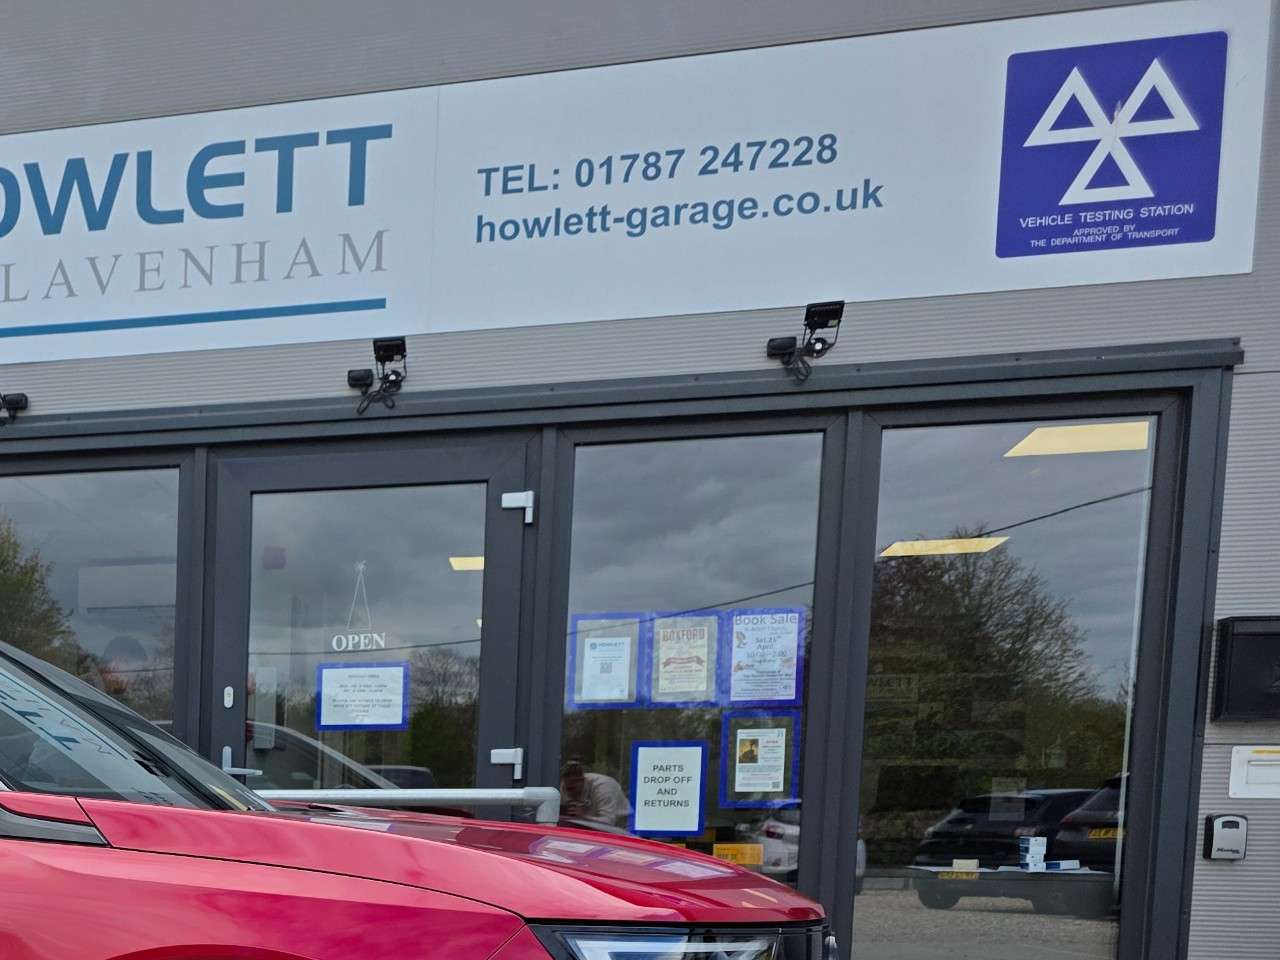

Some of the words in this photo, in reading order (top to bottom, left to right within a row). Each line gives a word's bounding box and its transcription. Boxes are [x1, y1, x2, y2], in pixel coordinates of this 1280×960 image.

[477, 163, 561, 197] TEL:
[575, 148, 686, 188] 01787
[697, 132, 839, 176] 247228
[475, 178, 885, 243] howlett-garage.co.uk
[1020, 213, 1073, 228] VEHICLE
[1079, 208, 1134, 223] TESTING
[1140, 204, 1194, 218] STATION
[1030, 239, 1047, 248] THE
[1050, 234, 1106, 247] DEPARTMENT
[1110, 232, 1123, 241] OF
[1127, 228, 1180, 239] TRANSPORT
[1072, 224, 1119, 236] APPROVED
[1123, 224, 1136, 233] BY
[0, 229, 389, 304] LAVENHAM
[735, 613, 767, 626] Book
[771, 612, 798, 625] Sale
[331, 632, 387, 651] OPEN
[652, 764, 684, 772] PARTS
[643, 776, 671, 784] DROP
[673, 776, 693, 784] OFF
[656, 787, 678, 796] AND
[643, 799, 690, 808] RETURNS
